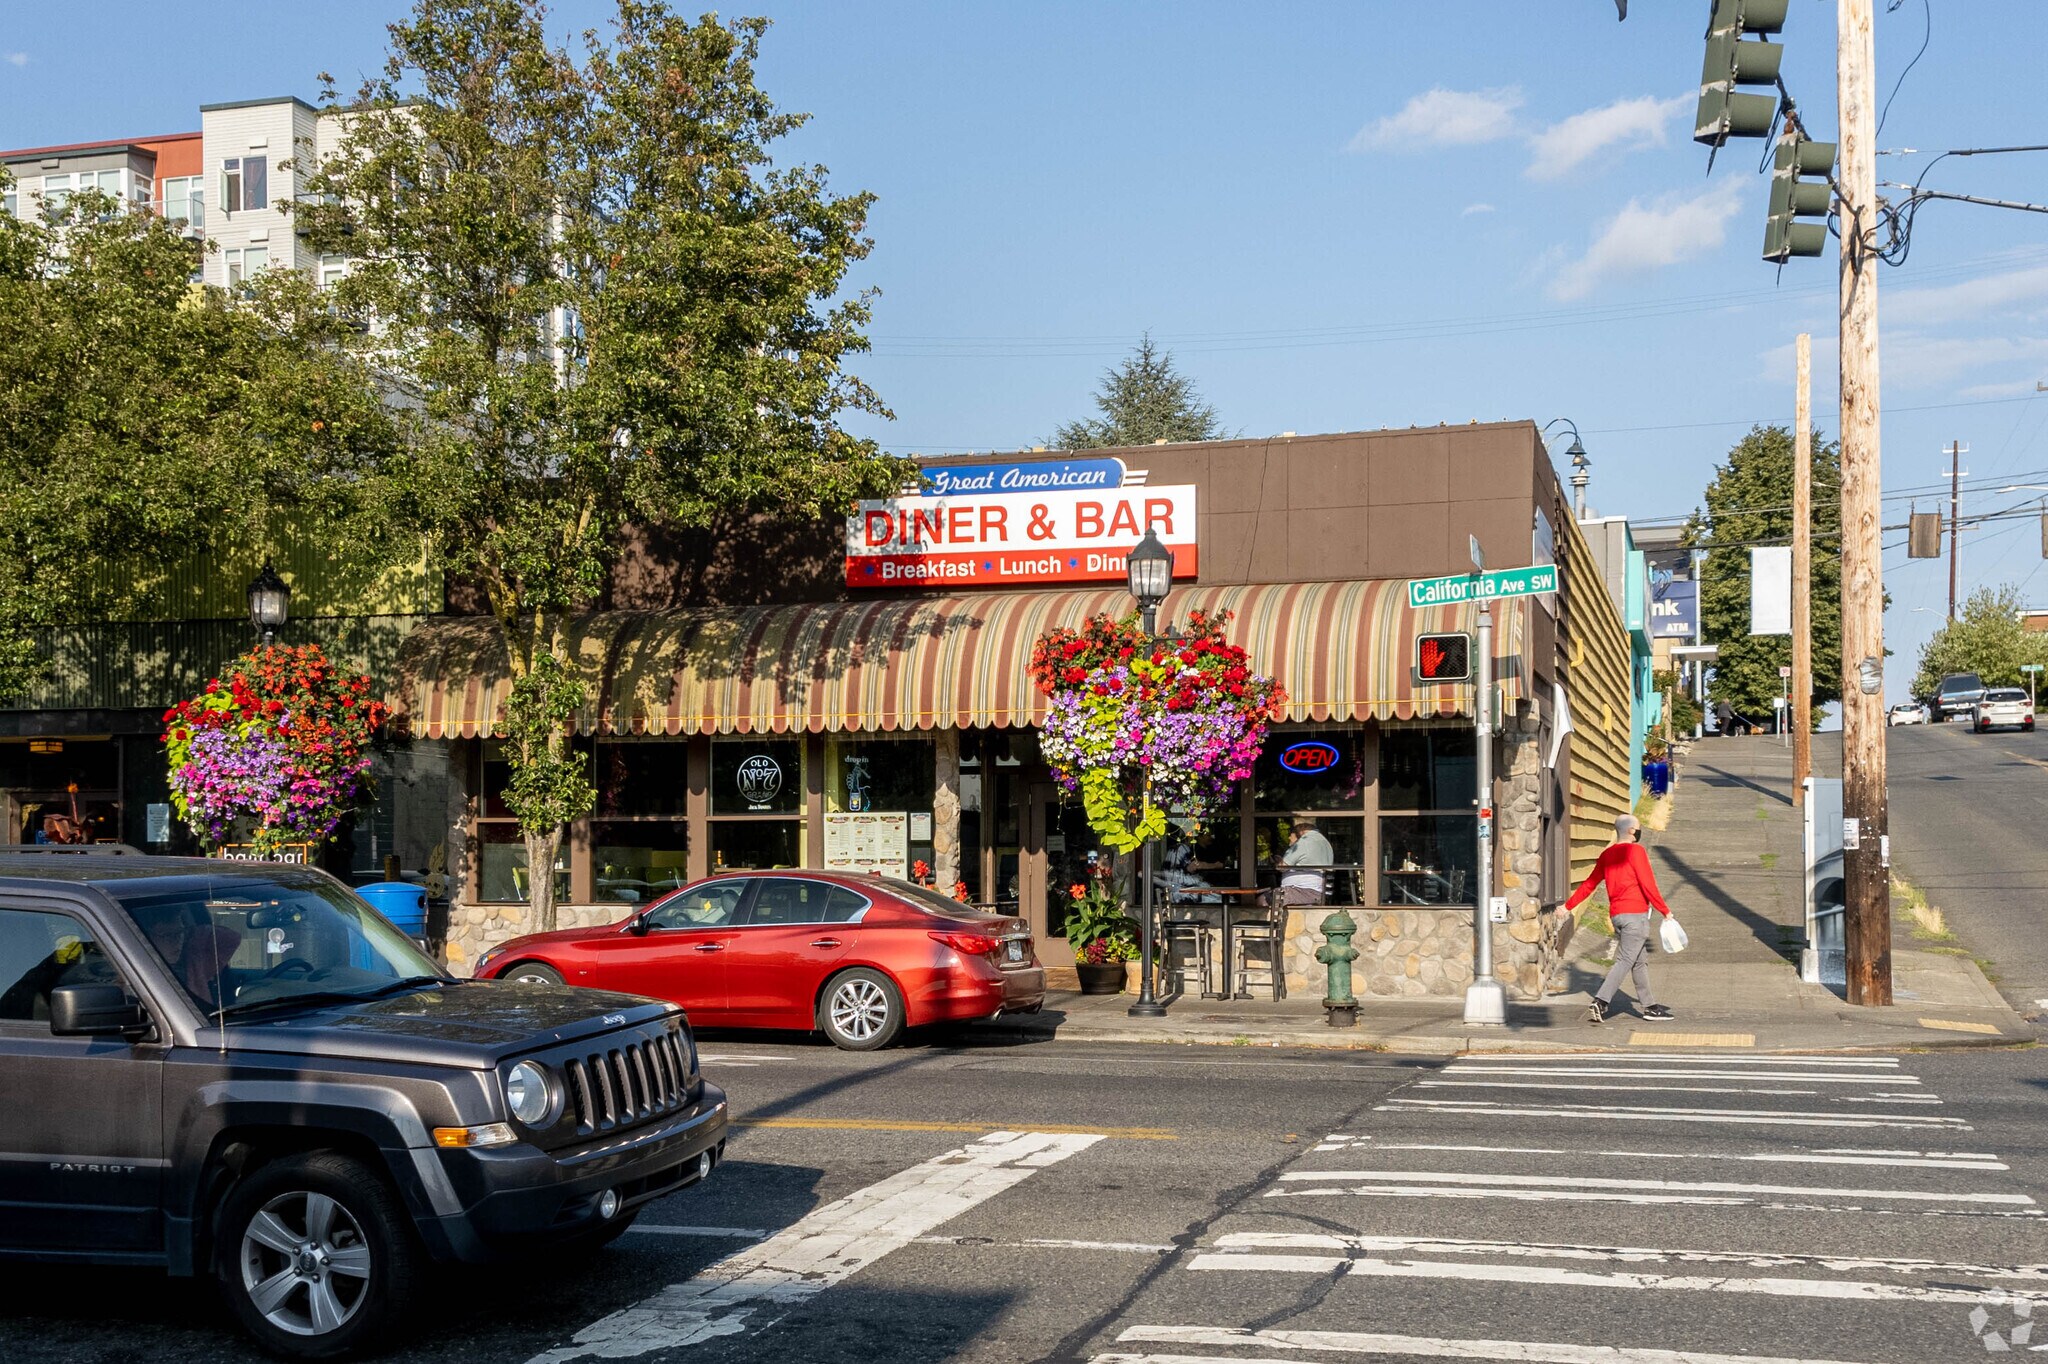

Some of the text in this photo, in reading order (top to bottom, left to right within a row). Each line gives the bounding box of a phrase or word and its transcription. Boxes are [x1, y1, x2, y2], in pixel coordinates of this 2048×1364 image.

[933, 466, 1107, 495] Great American
[865, 498, 1175, 547] DINER & BAR
[882, 554, 1127, 579] Breakfast Lunch Din
[1413, 574, 1553, 603] California Ave SW
[1652, 598, 1679, 616] nk
[1666, 622, 1689, 632] ATM
[1284, 749, 1335, 767] OPEN
[49, 1162, 136, 1174] PATRIOT
